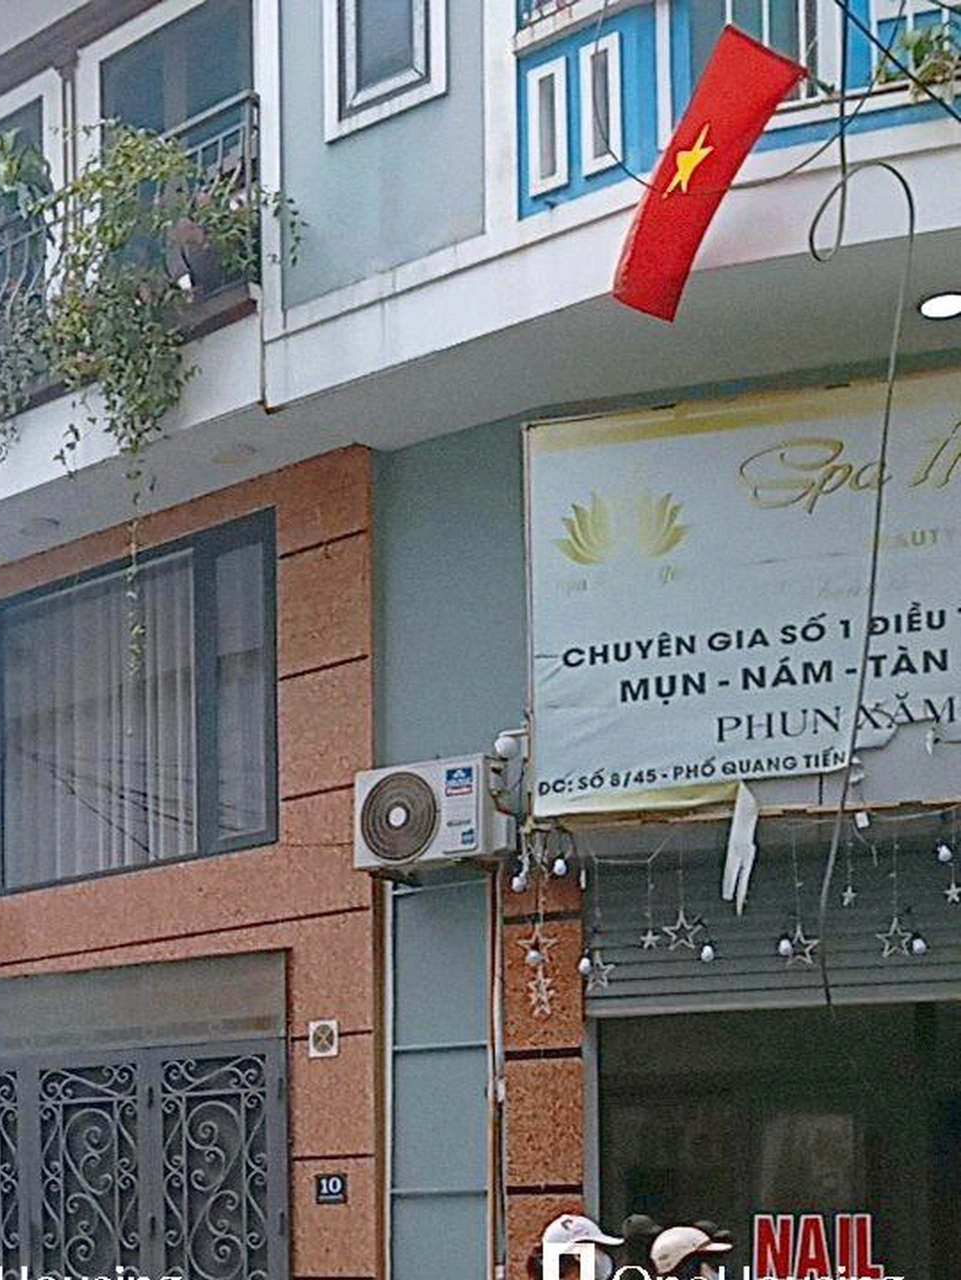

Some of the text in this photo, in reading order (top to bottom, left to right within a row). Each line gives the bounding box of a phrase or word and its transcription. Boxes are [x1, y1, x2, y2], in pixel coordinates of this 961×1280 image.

[740, 436, 893, 515] Spa
[562, 631, 697, 668] CHUYÊN
[707, 627, 770, 651] GIA
[780, 612, 827, 645] SỐ
[839, 618, 851, 639] 1
[868, 602, 946, 636] ĐIỀU
[619, 671, 707, 706] MỤN
[742, 655, 833, 691] NÁM
[868, 646, 949, 678] TÀN
[716, 706, 841, 743] PHUN
[609, 768, 658, 789] 8/45
[672, 756, 717, 781] PHỐ
[721, 755, 798, 776] QUANG
[804, 746, 847, 770] TIẾN
[320, 1177, 342, 1193] 10
